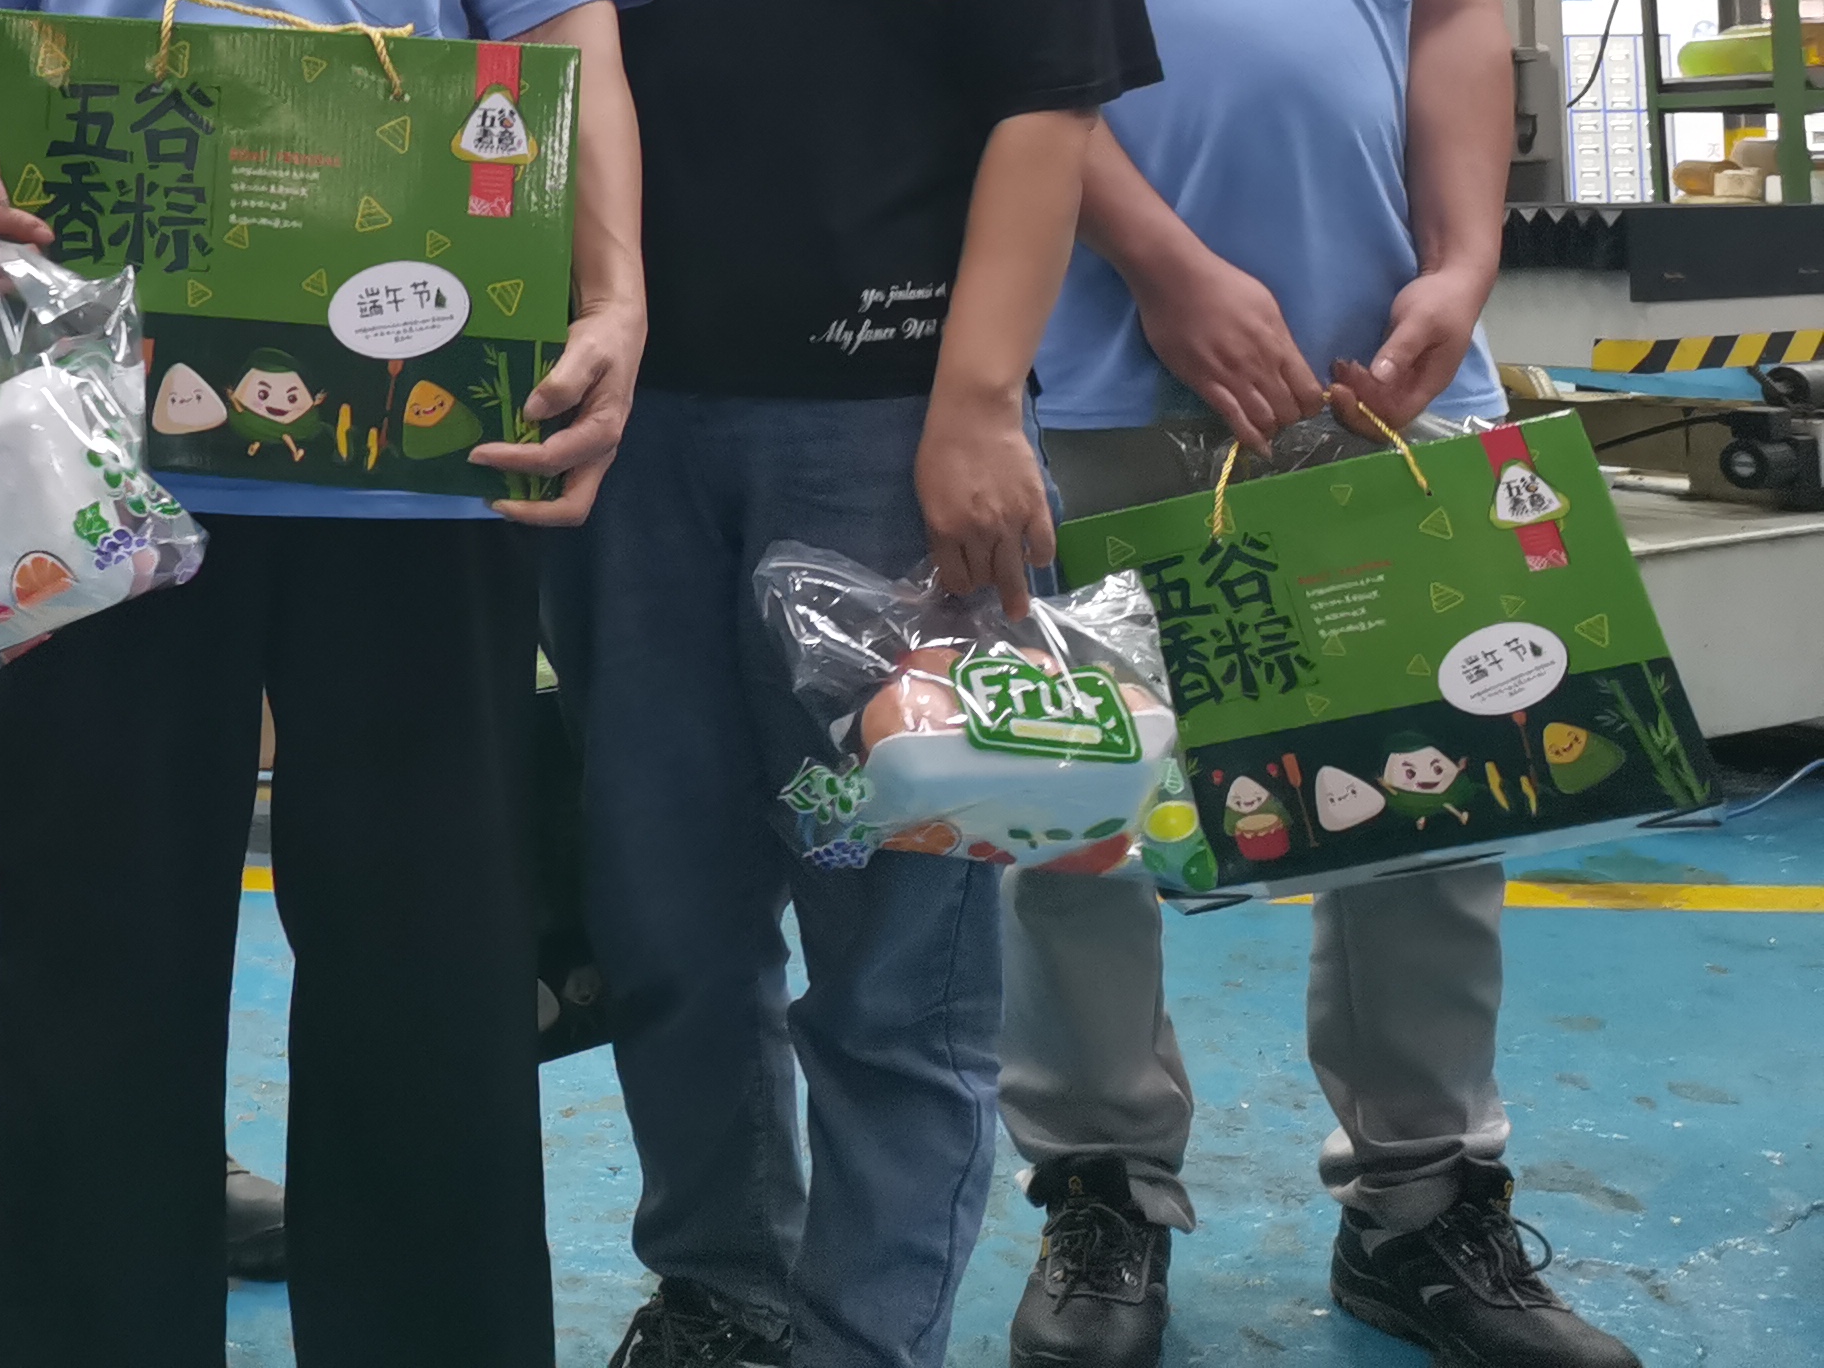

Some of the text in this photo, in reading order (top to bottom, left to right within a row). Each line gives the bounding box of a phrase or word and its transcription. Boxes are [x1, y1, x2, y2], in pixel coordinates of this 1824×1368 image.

[45, 81, 216, 172] 五谷
[35, 161, 214, 274] 香粽
[356, 280, 432, 319] 端午节
[1141, 531, 1279, 621] 五谷
[969, 664, 1105, 720] Frut
[1160, 614, 1317, 716] 香粽
[1460, 636, 1528, 685] 端午节
